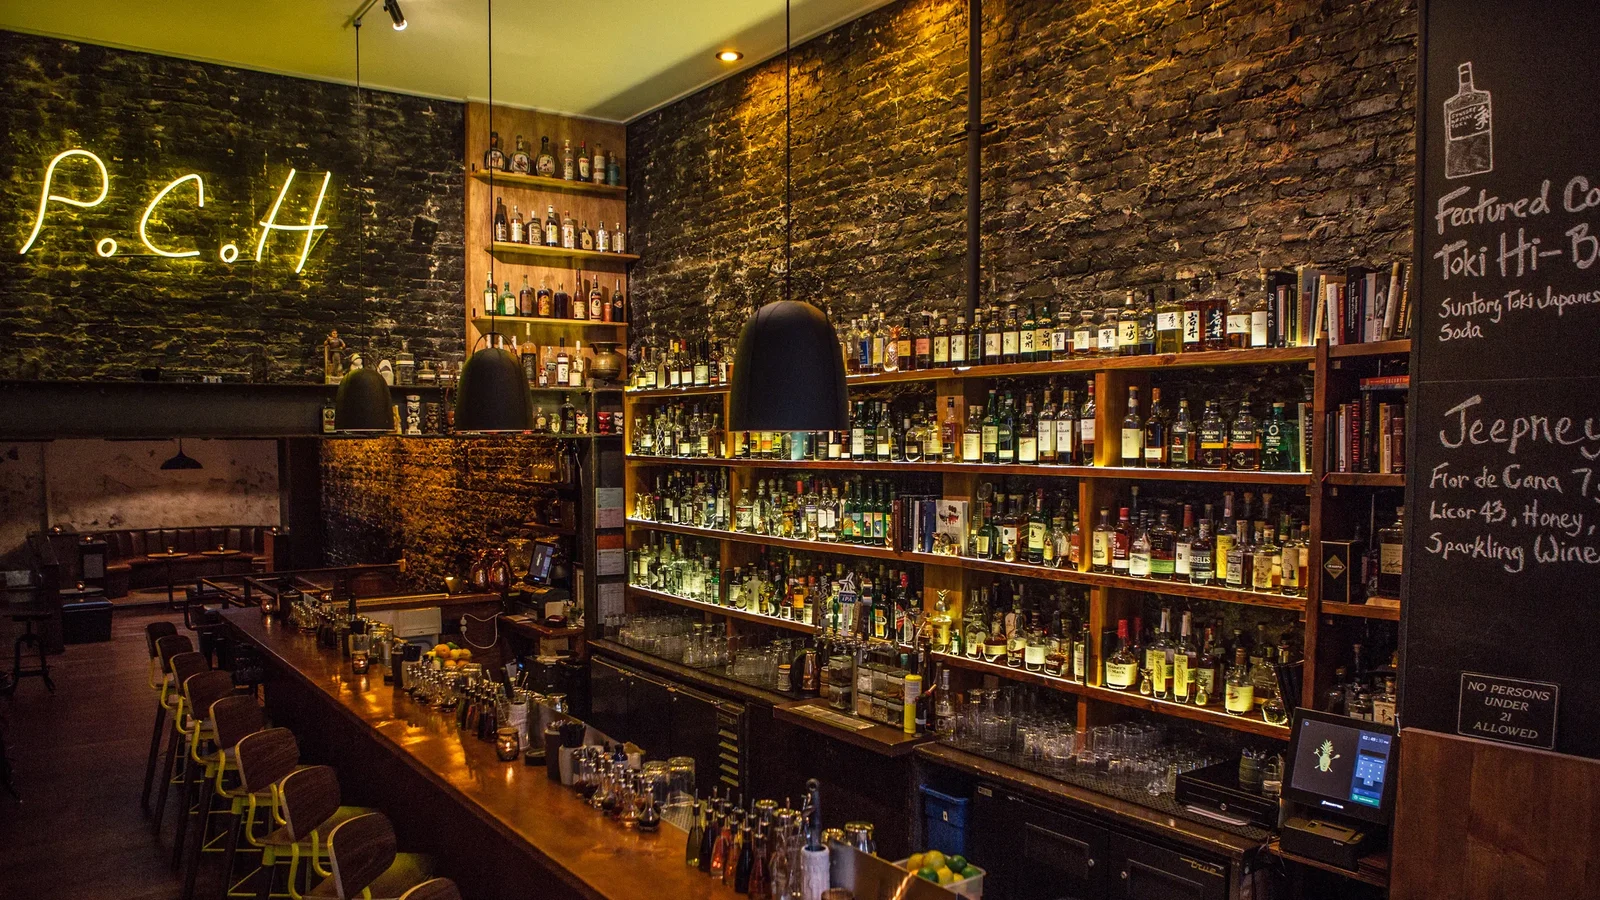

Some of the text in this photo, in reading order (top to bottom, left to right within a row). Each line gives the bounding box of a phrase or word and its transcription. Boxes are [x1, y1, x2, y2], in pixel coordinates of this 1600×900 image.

[1435, 179, 1550, 235] Featured
[1433, 239, 1488, 280] Toki
[1438, 291, 1502, 324] Suntory
[1504, 289, 1533, 310] Toki
[1438, 321, 1484, 342] Soda
[1474, 466, 1498, 489] de
[1502, 463, 1563, 494] Cana
[1572, 467, 1600, 503] 7
[1429, 500, 1476, 521] Licor
[1425, 532, 1600, 573] Sparkling Wine
[1467, 681, 1551, 701] NO PERSONS
[1484, 696, 1530, 712] UNDER
[1500, 712, 1512, 722] 21
[1472, 721, 1539, 739] ALLOWED
